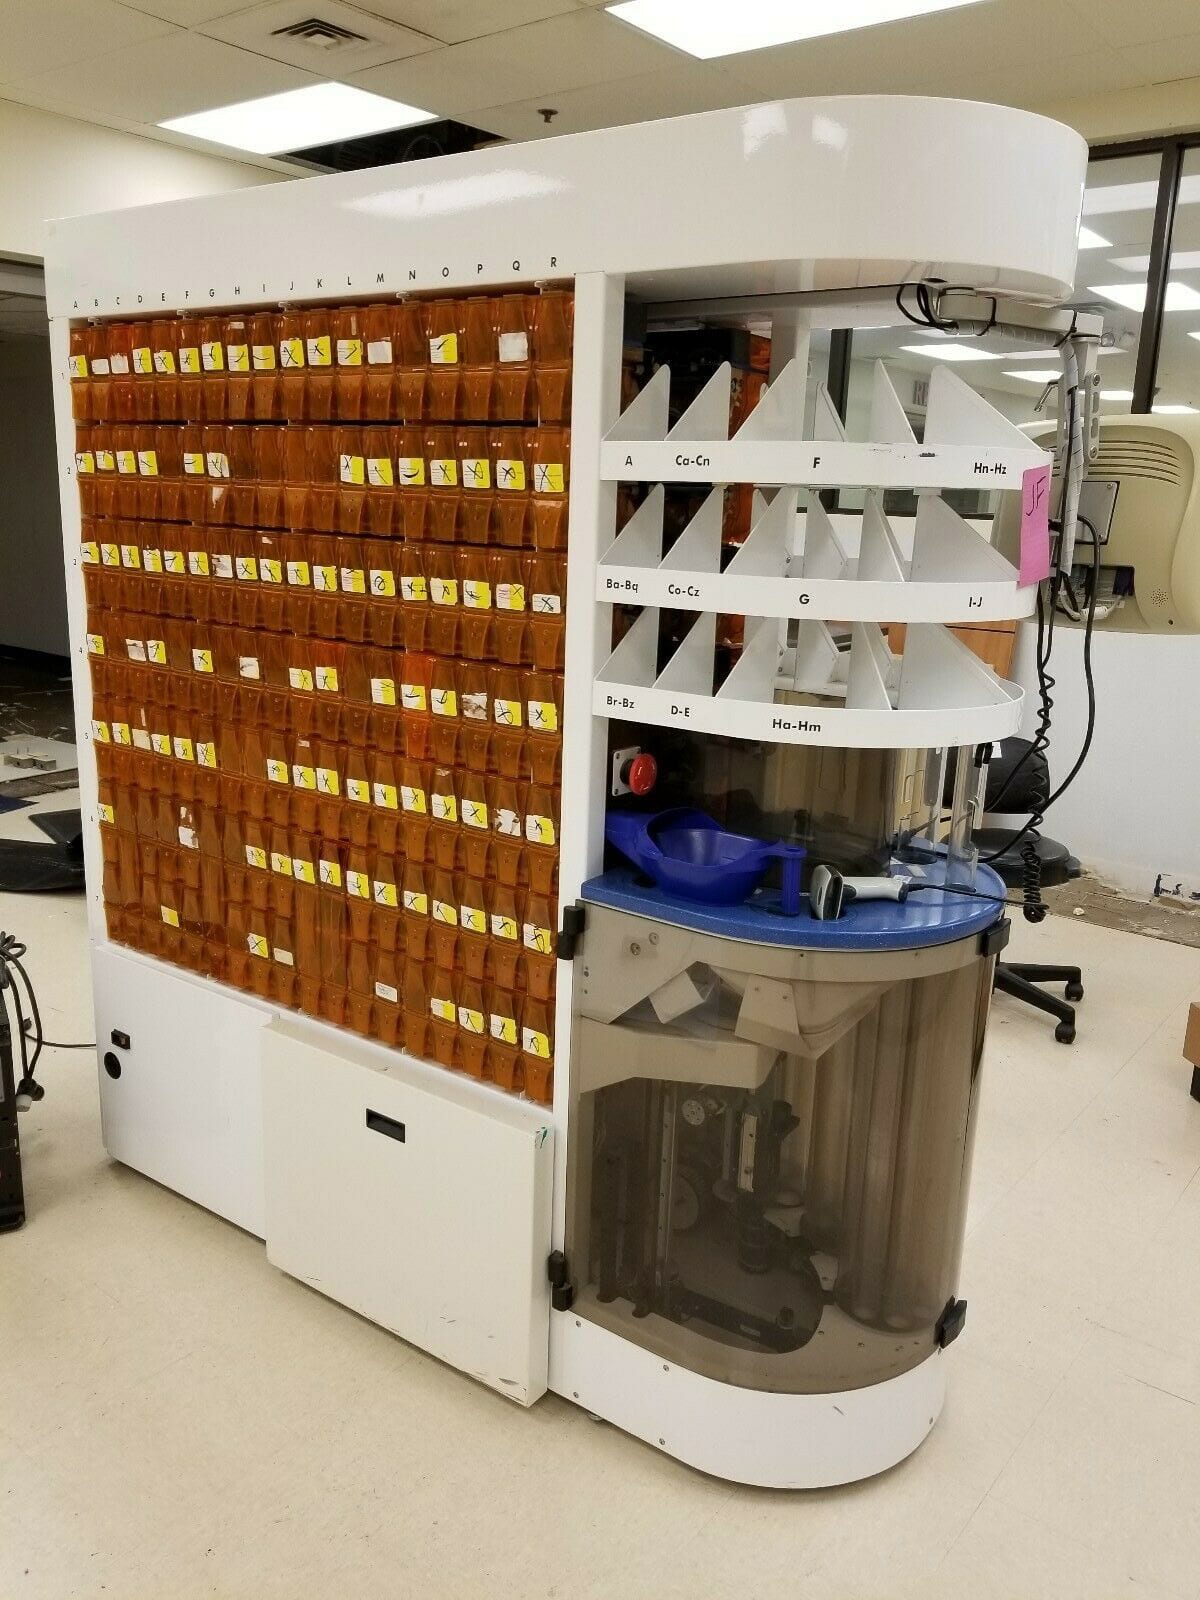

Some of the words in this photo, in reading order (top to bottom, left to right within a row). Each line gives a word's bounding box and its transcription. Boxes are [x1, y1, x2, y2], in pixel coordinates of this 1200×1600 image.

[624, 455, 633, 467] A
[675, 454, 711, 467] Ca-Cn
[812, 457, 821, 469] F
[973, 462, 1008, 475] Hn-Hz
[606, 578, 639, 594] Ba-Bq
[668, 584, 700, 598] Co-Cz
[799, 594, 810, 606] G
[968, 596, 984, 608] I-J
[606, 695, 635, 709] Br-Bz
[671, 705, 691, 718] D-E
[772, 718, 822, 733] Ha-Hm
